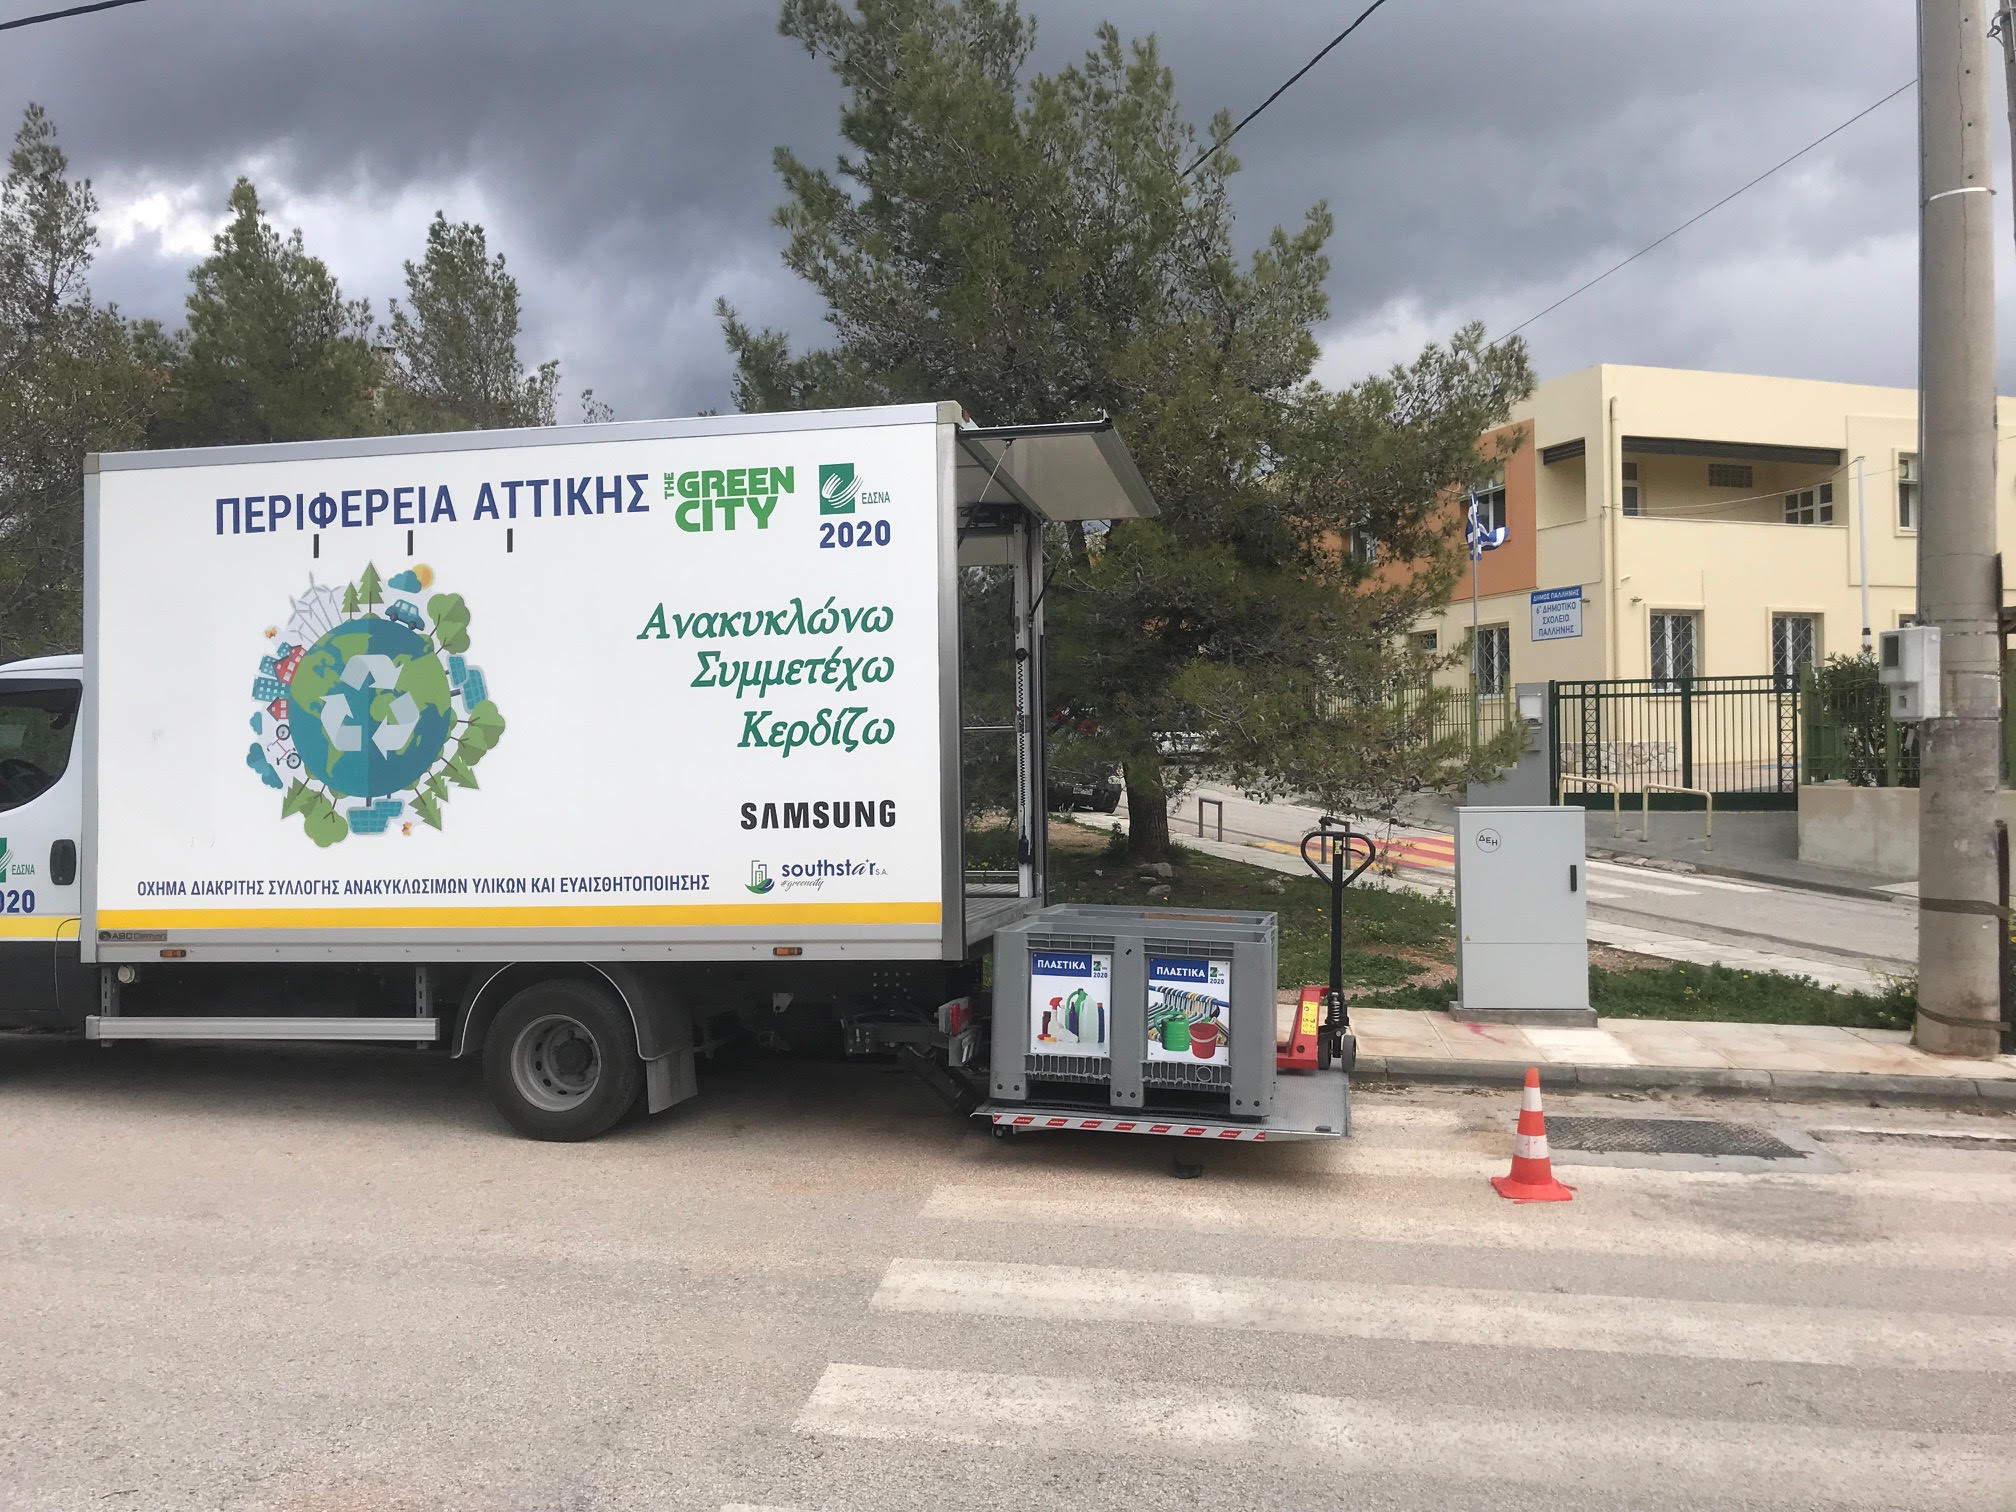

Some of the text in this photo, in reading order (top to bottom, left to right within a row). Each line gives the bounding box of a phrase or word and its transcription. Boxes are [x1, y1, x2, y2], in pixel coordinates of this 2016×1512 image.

[663, 472, 675, 499] THE
[677, 466, 795, 498] GREEN
[216, 473, 650, 535] ΠΕΡΙΦΕΡΕΙΑ ΑΤΤΙΚΗΣ
[675, 496, 778, 532] CITY
[819, 519, 891, 548] 2020
[636, 596, 895, 640] Ανακυκλώνω
[1542, 614, 1570, 625] ΣΧΟΛΕΙΟ
[1543, 601, 1577, 613] ΔΗΜΟΤΙΚΟ
[1538, 624, 1575, 637] ΠΑΛΛΗΝΗΣ
[690, 646, 895, 699] Συμμετέχω
[737, 706, 895, 758] Κερδίζω
[740, 800, 896, 830] SAMSUNG
[1478, 834, 1498, 846] ΔΕΗ
[137, 874, 710, 896] ΟΧΗΜΑ ΔΙΑΚΡΙΤΗΣ ΣΥΛΛΟΓΗΣ ΑΝΑΚΥΚΛΩΣΙΜΩΝ ΥΛΙΚΩΝ ΚΑΙ ΕΥΑΙΣΘΗΤΟΠΟΙΗΣΗΣ
[1037, 959, 1086, 970] ΠΛΑΣΤΙΚΑ
[1156, 966, 1206, 978] ΠΛΑΣΤΙΚΑ
